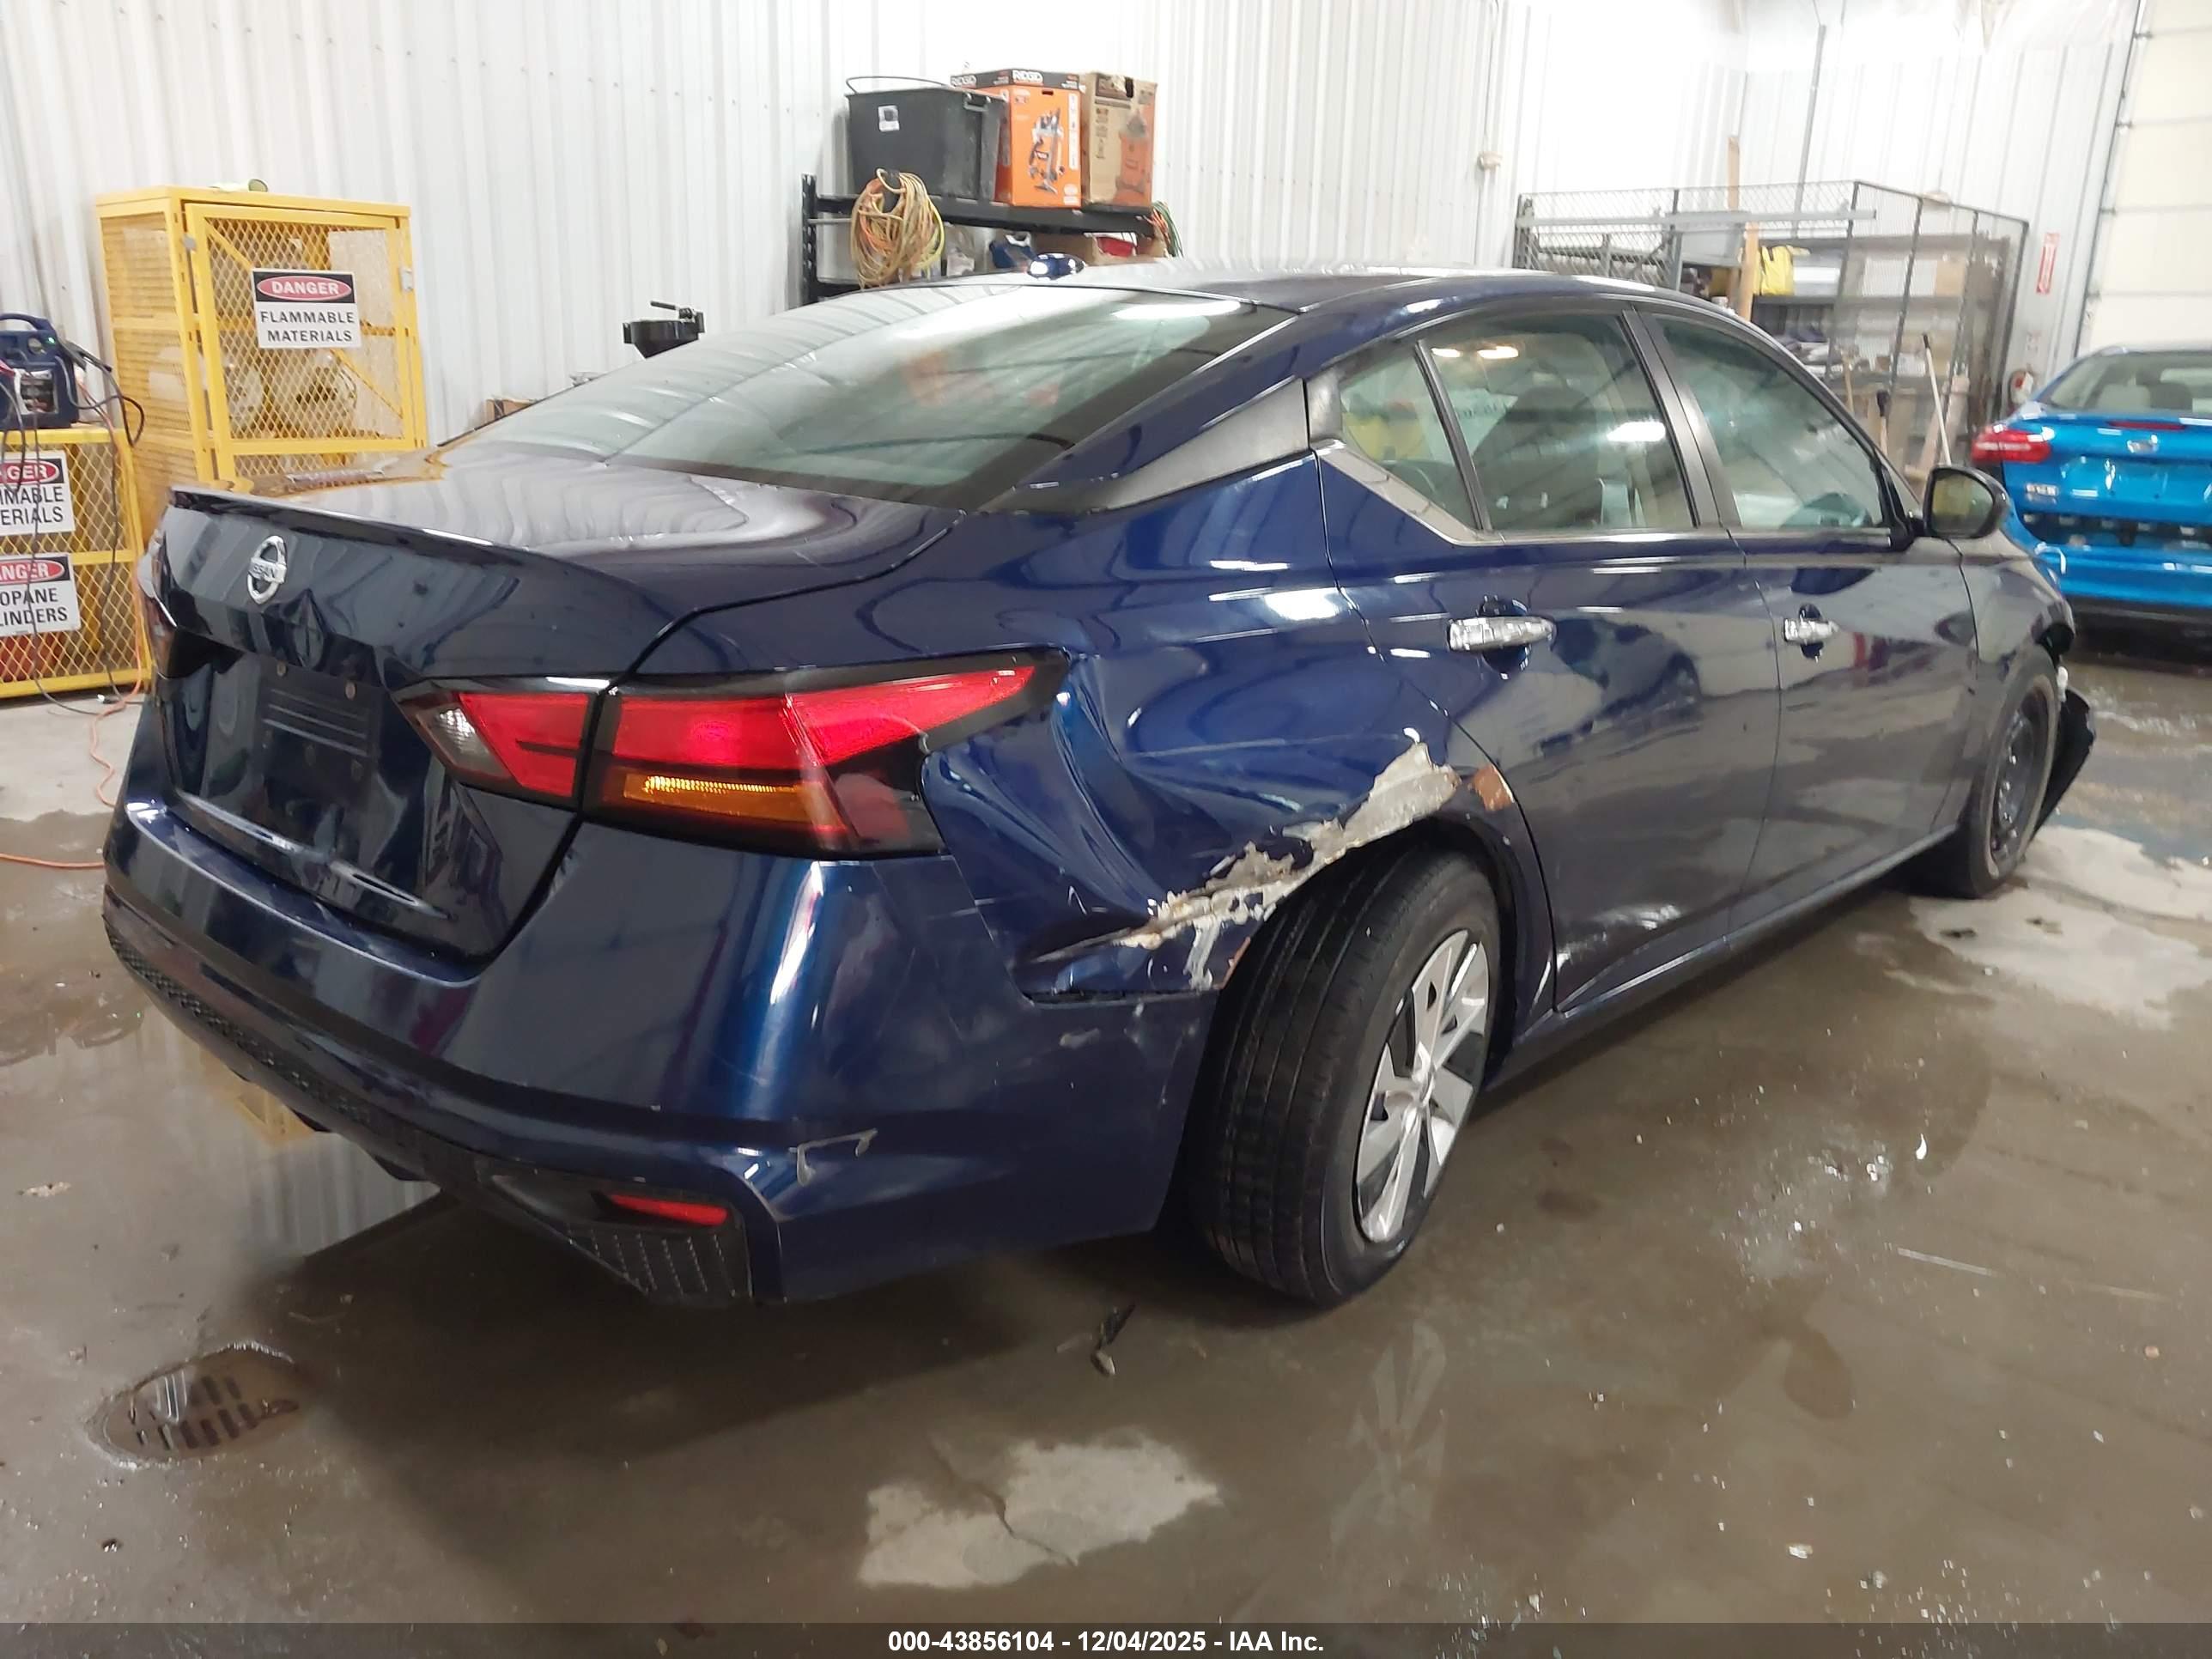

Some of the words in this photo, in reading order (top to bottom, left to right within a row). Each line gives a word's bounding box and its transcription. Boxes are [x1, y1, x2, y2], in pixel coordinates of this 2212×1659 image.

[271, 281, 339, 295] DANGER
[260, 311, 355, 323] FLAMMABLE
[267, 330, 352, 342] MATERIALS
[0, 465, 48, 480] GER
[0, 486, 64, 505] MABLE
[0, 562, 49, 580] NGER
